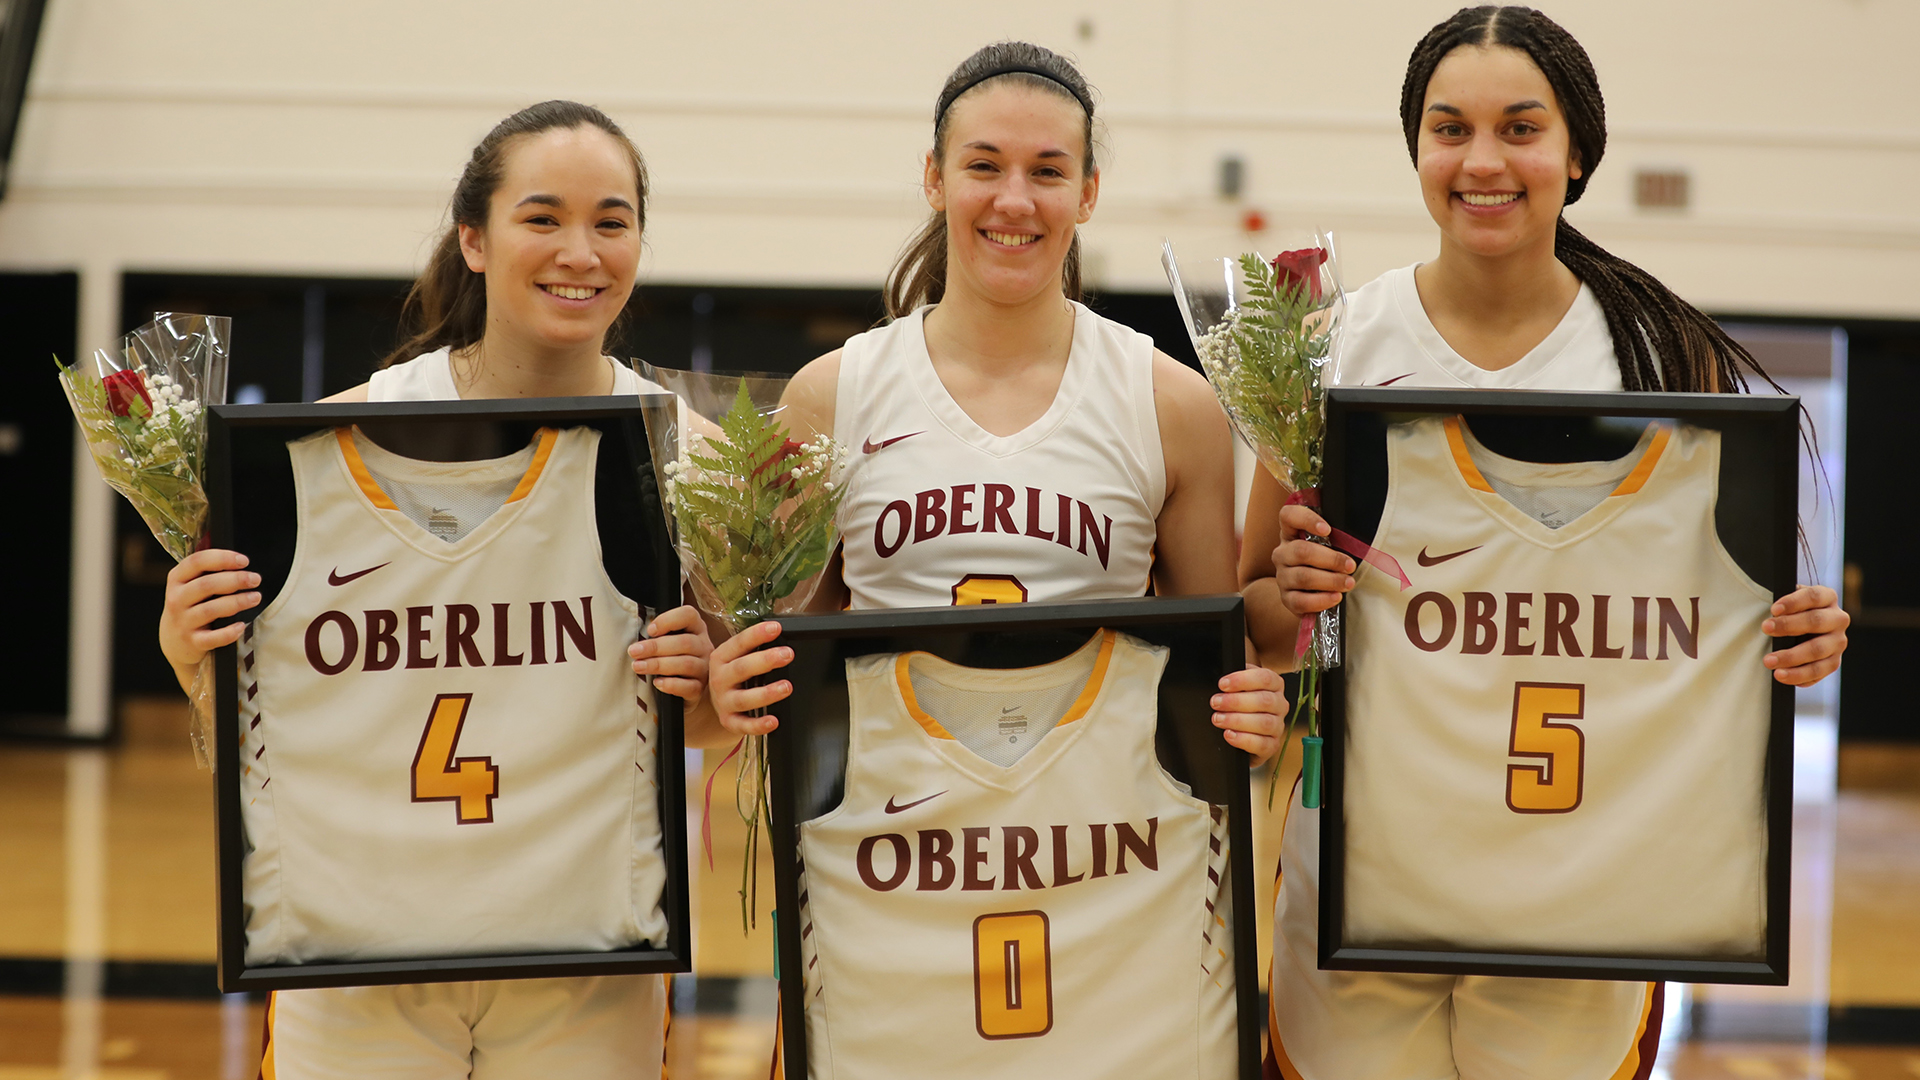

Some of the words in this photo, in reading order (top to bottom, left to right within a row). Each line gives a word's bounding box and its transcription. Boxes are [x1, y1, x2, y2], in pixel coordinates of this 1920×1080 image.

[873, 483, 1113, 573] OBERLIN
[304, 595, 597, 676] OBERLIN
[1403, 590, 1701, 661] OBERLIN
[410, 692, 500, 826] 4
[1505, 680, 1586, 815] 5
[856, 816, 1159, 892] OBERLIN
[972, 909, 1054, 1041] 0
